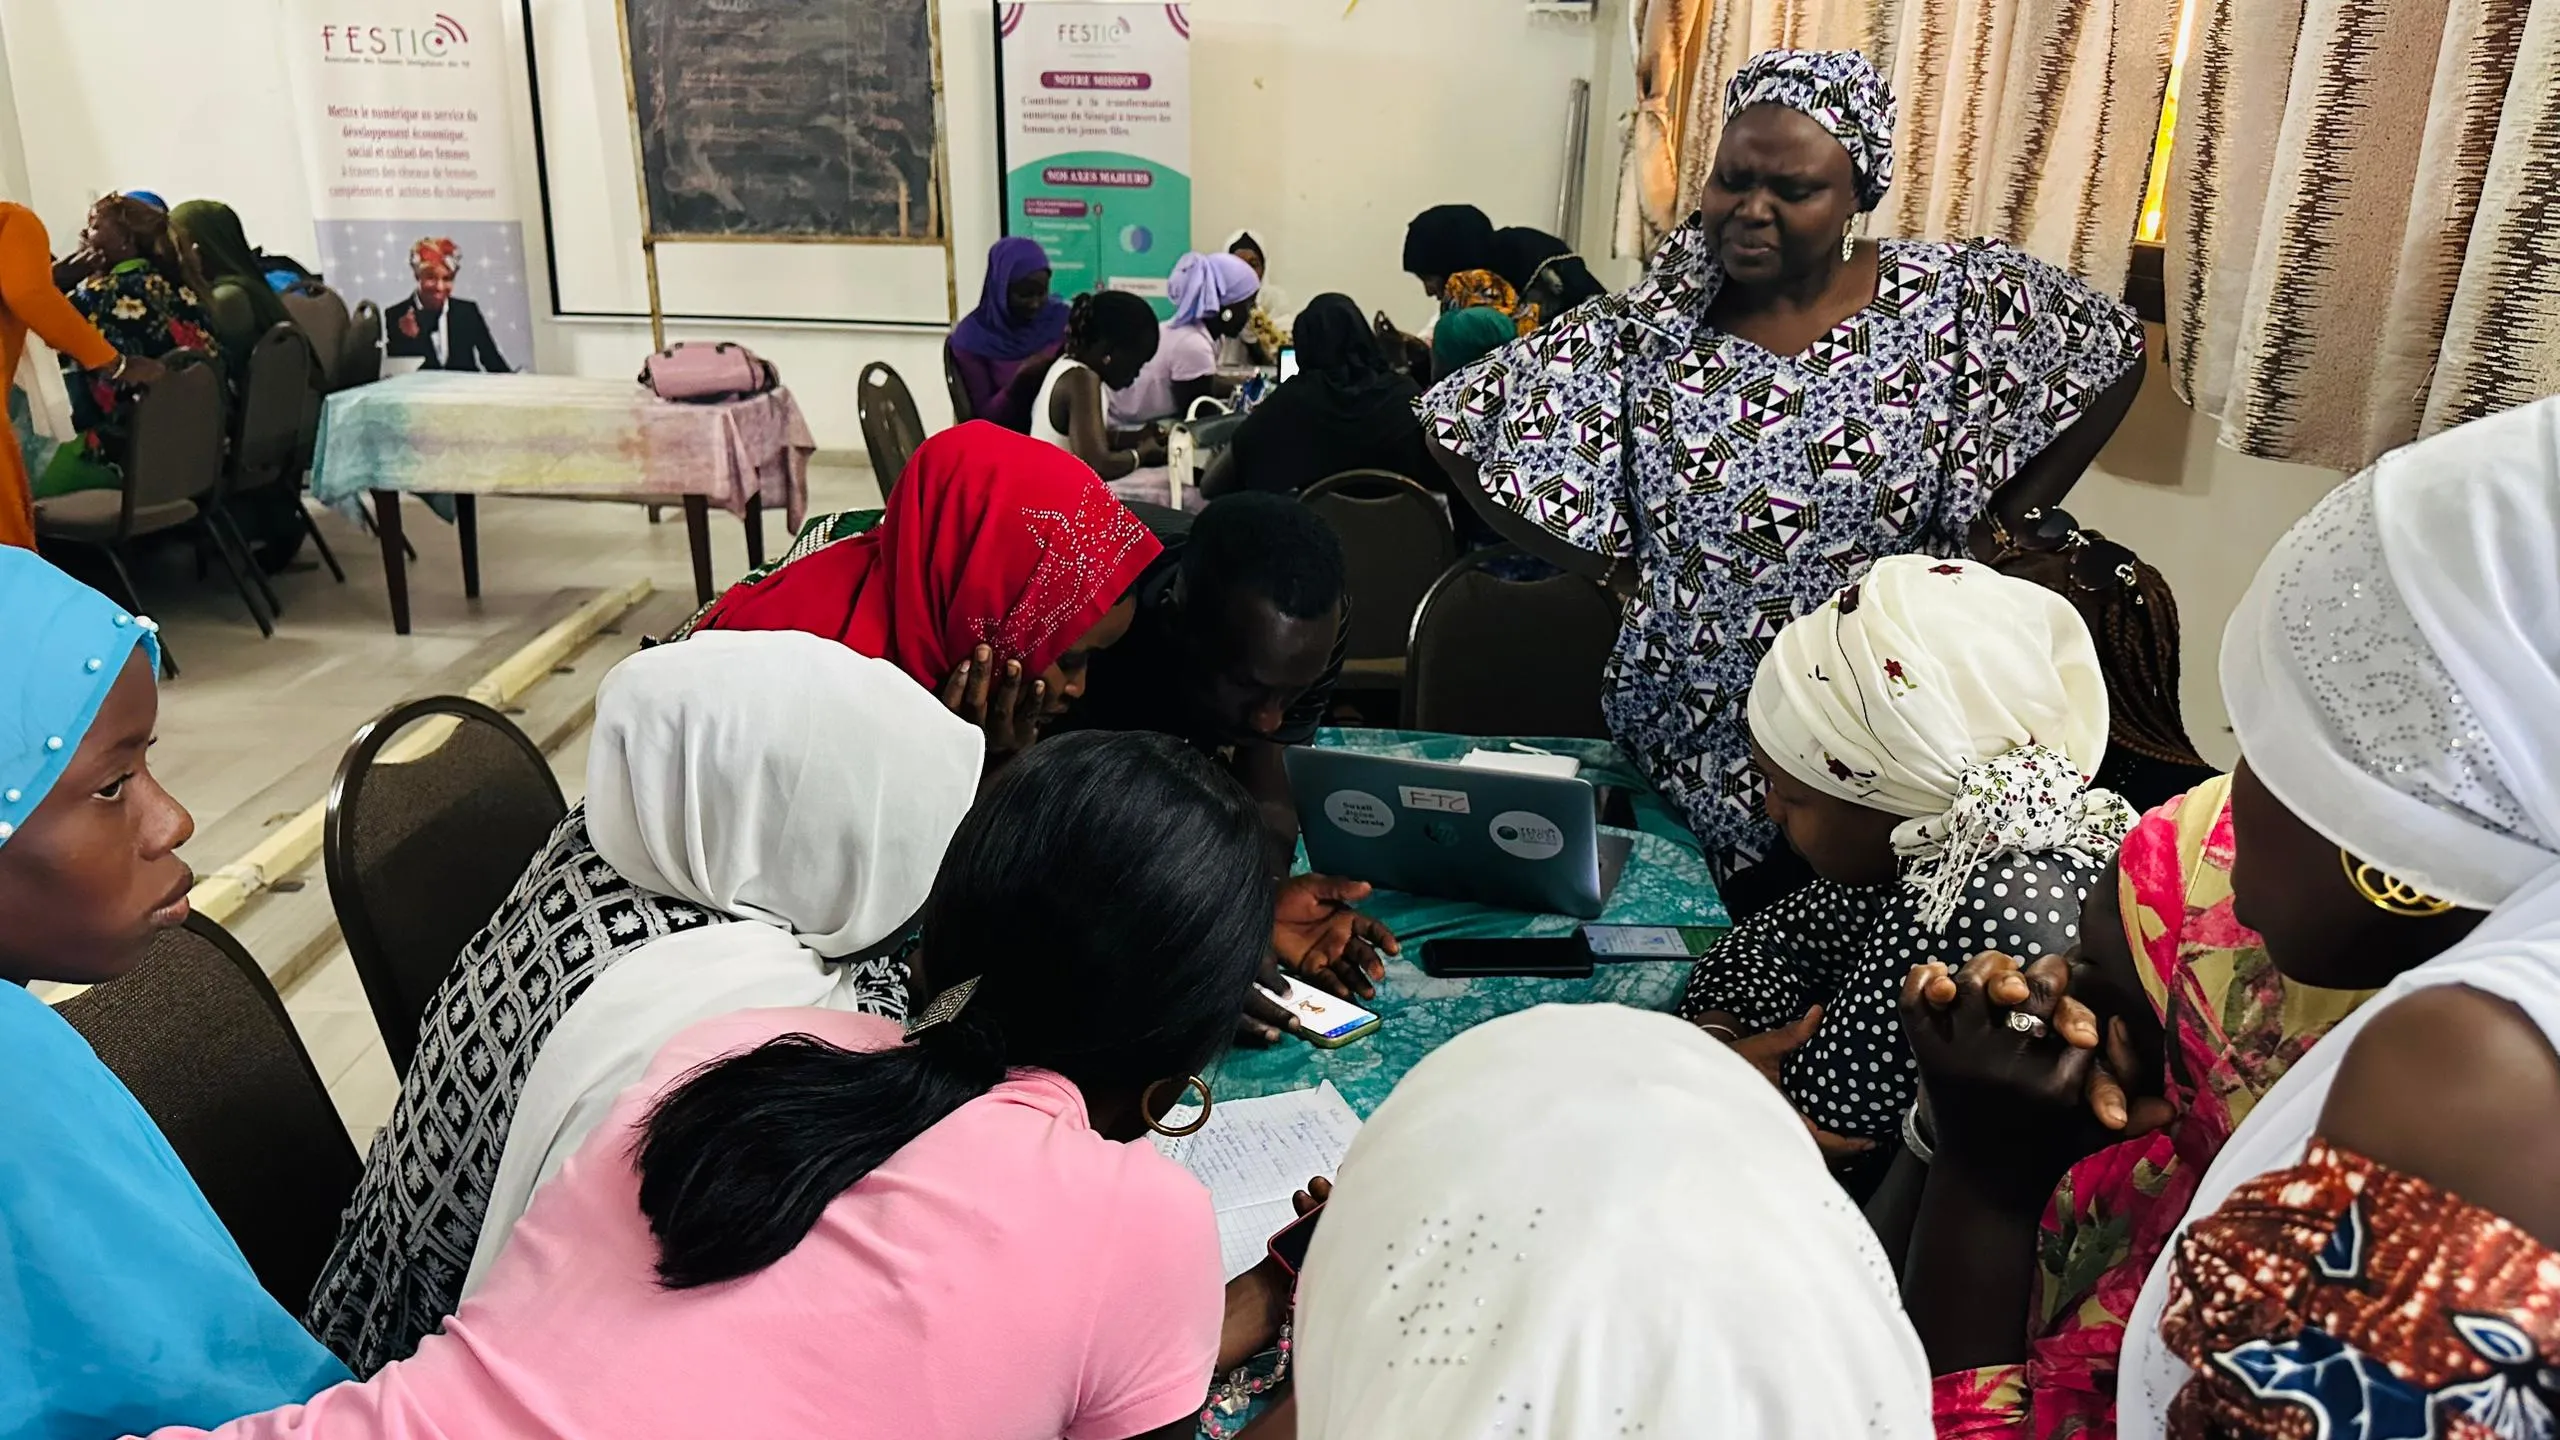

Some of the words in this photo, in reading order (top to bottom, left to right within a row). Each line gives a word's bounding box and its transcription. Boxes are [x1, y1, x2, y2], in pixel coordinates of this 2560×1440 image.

[322, 25, 448, 57] FESTIC
[1058, 23, 1122, 43] FESTIC
[1054, 74, 1091, 86] NOTRE
[1093, 75, 1139, 88] MISSION
[1047, 170, 1068, 181] NOS
[1070, 171, 1098, 182] AXES
[1100, 172, 1150, 184] MAJEURS
[1410, 791, 1467, 812] FTC
